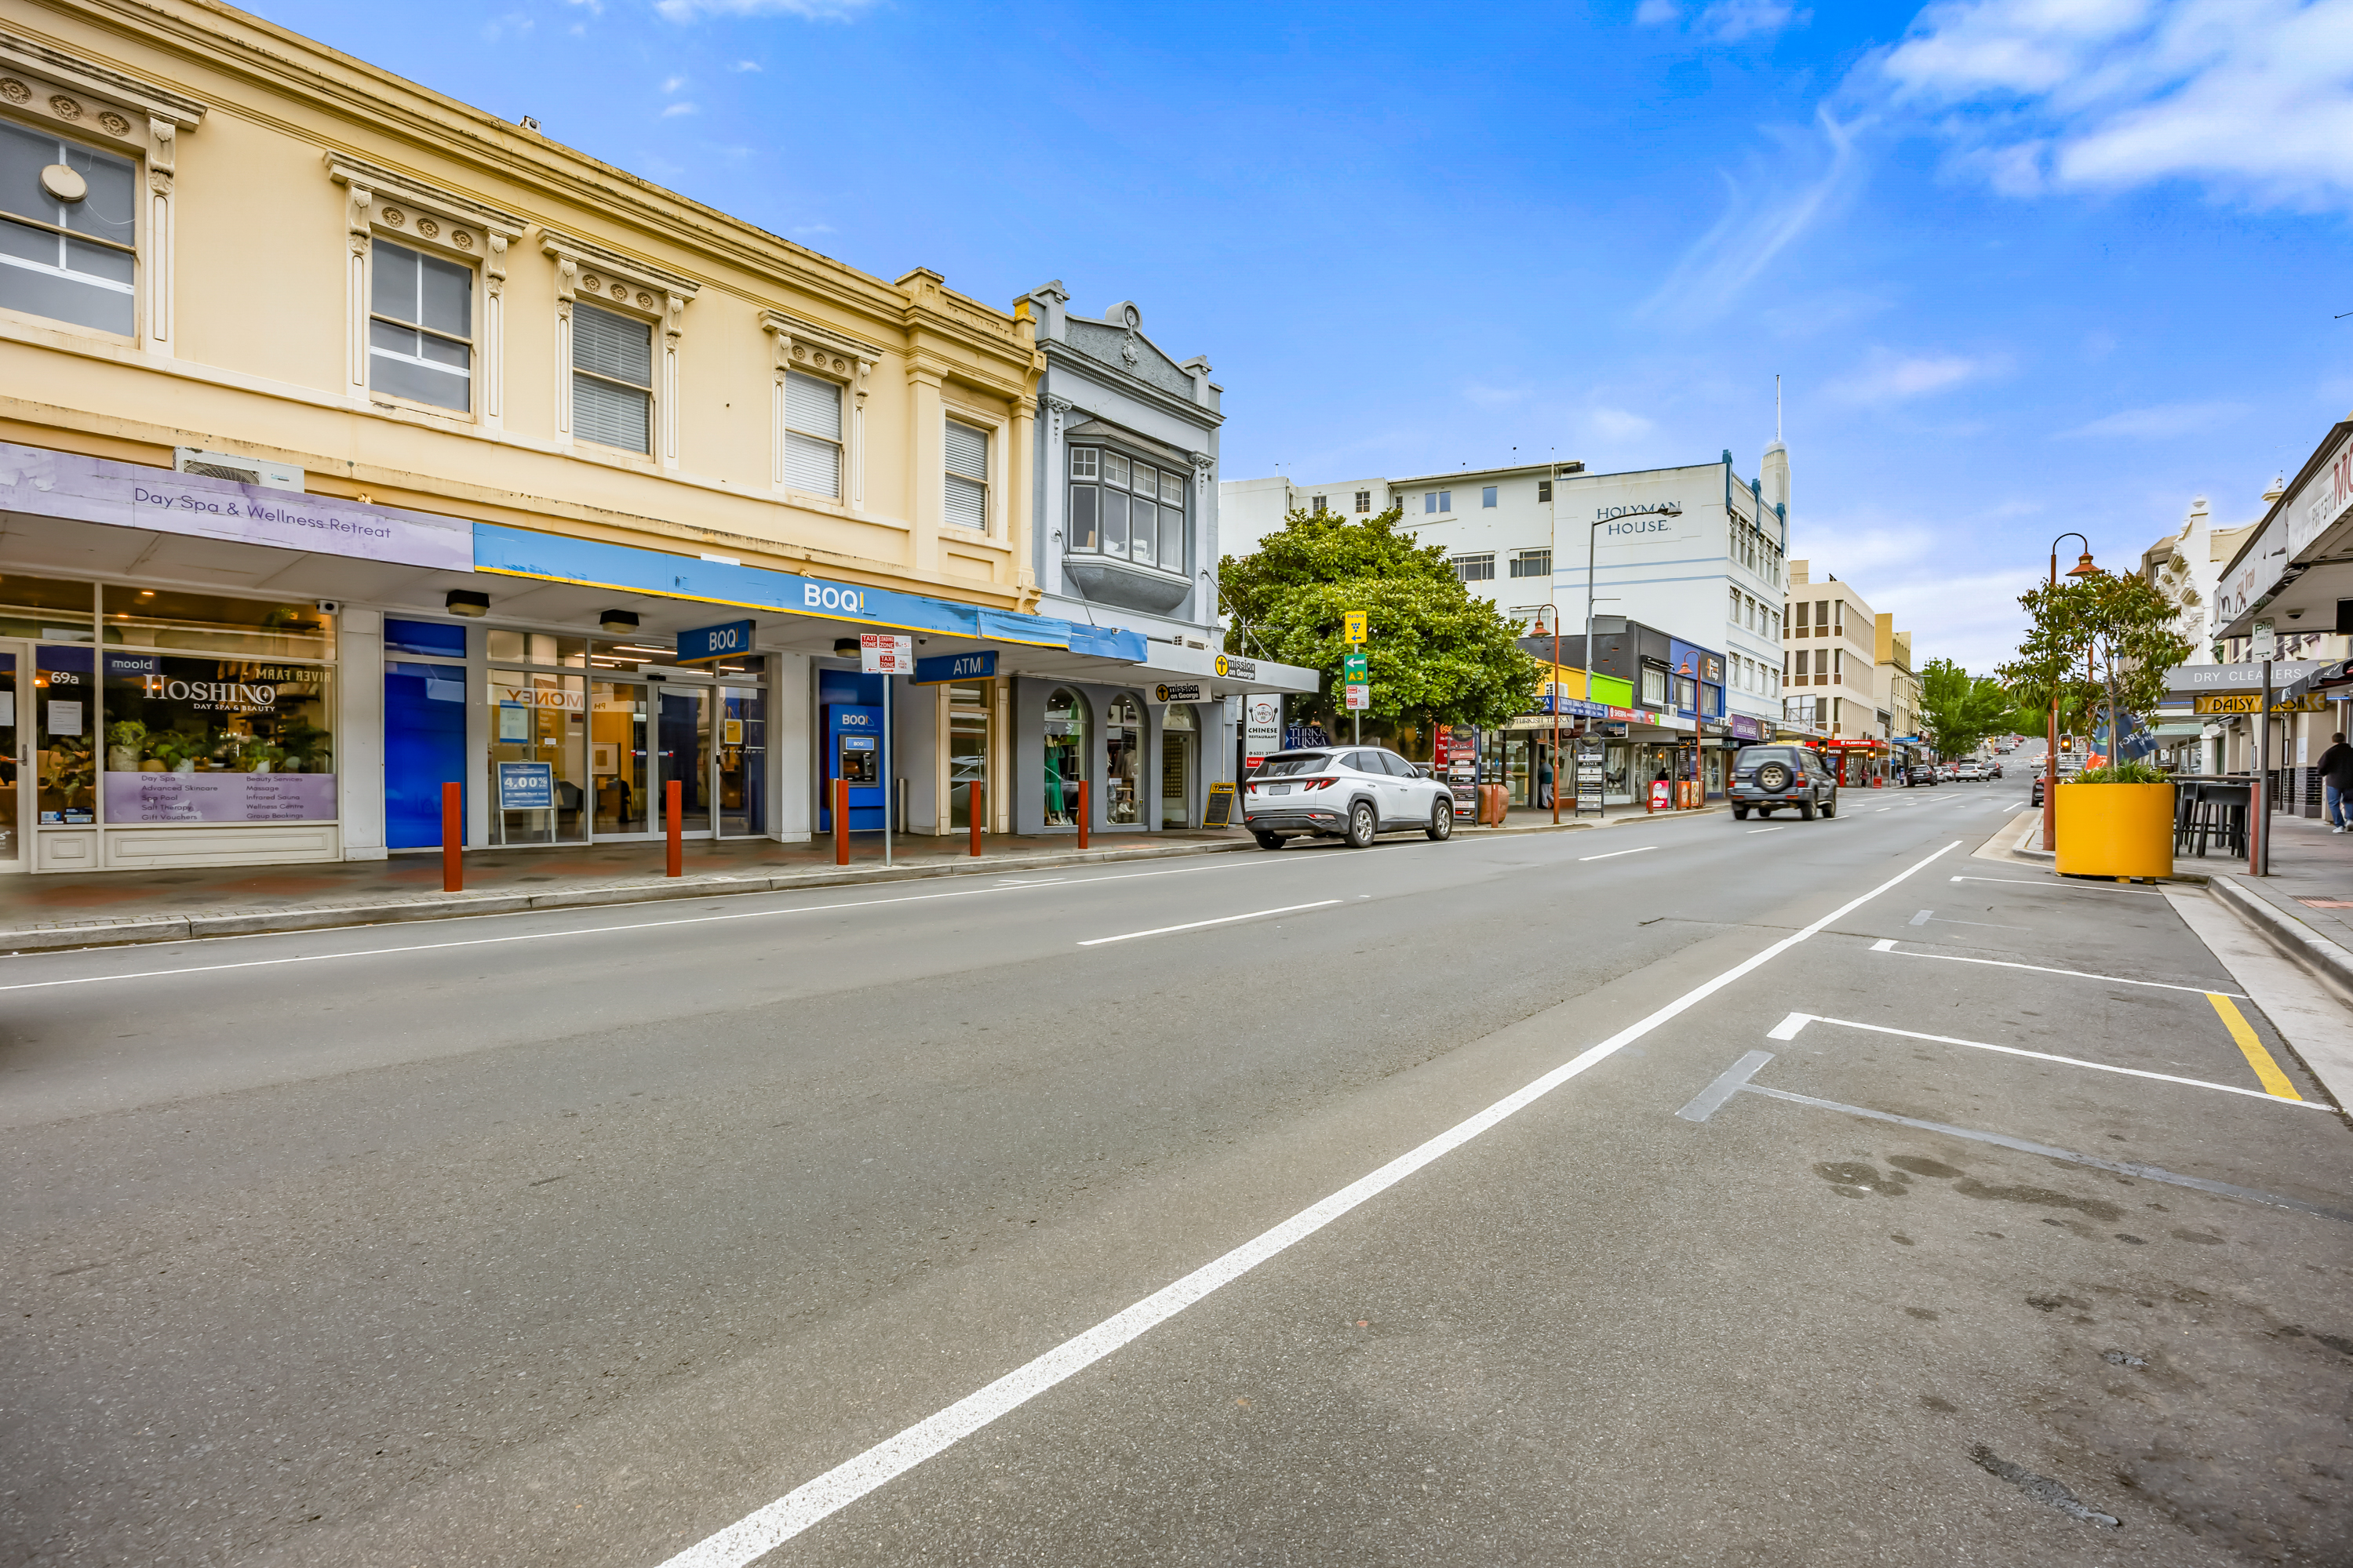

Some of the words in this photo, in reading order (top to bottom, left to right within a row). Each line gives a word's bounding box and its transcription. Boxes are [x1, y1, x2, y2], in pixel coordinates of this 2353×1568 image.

[134, 487, 174, 508] Day
[180, 495, 219, 515] Spa
[227, 503, 239, 516] &
[247, 505, 324, 529] Wellness
[330, 518, 392, 539] Retreat
[804, 583, 858, 613] BOQ
[708, 628, 736, 652] BOQ
[952, 657, 981, 675] ATM
[1228, 658, 1255, 671] mission
[50, 671, 79, 685] 69a
[1237, 669, 1255, 678] George
[1348, 671, 1365, 682] A3
[2194, 671, 2221, 682] DRY
[143, 674, 275, 706] HOSHINO
[1169, 683, 1199, 693] mission
[2213, 697, 2254, 711] DAISY
[1614, 709, 1627, 718] SHERPA
[842, 715, 865, 726] BOQ
